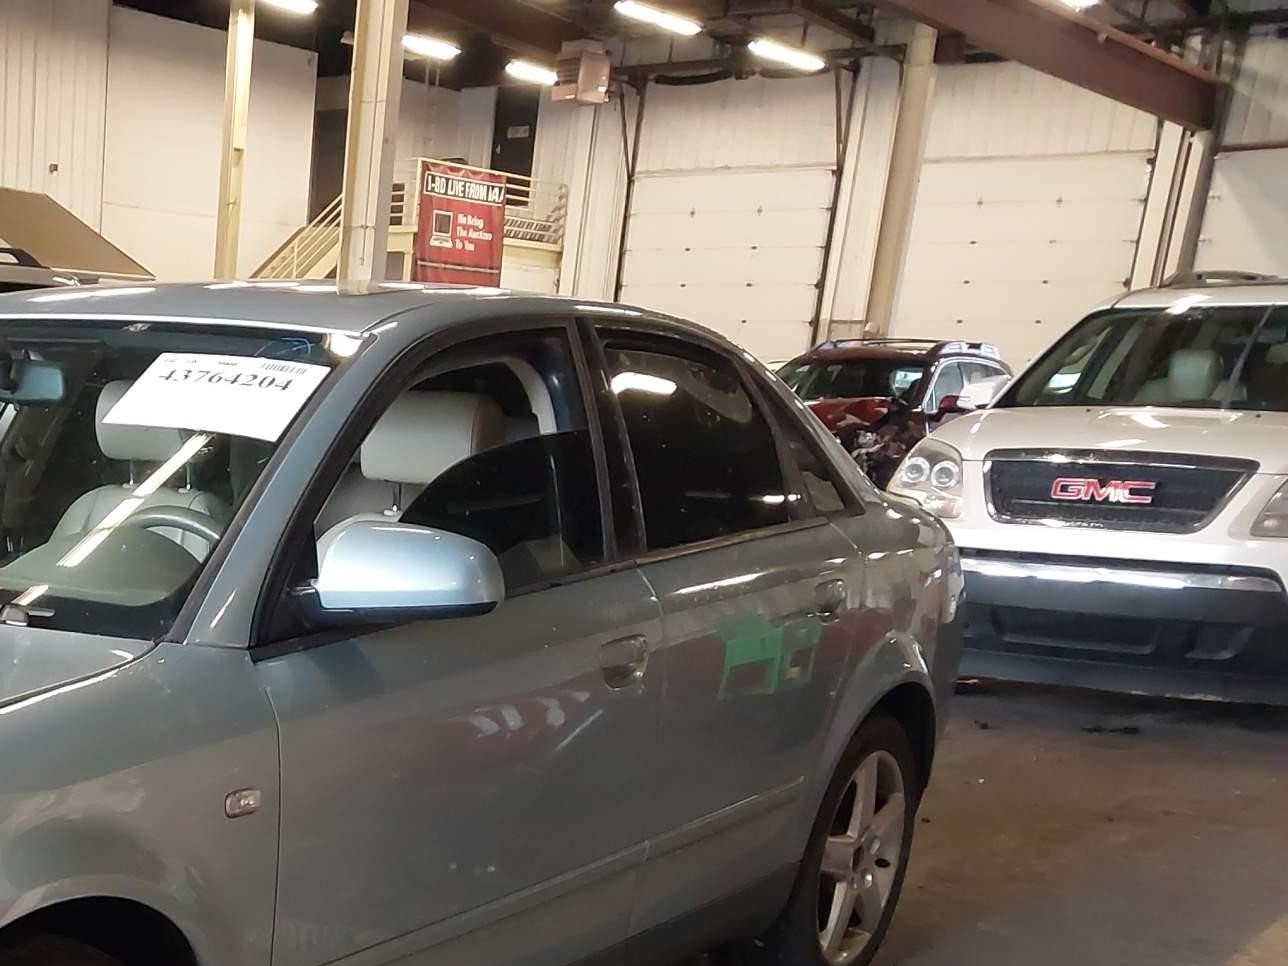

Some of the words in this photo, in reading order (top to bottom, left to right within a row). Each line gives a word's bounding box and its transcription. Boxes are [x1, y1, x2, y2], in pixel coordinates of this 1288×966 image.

[447, 179, 465, 197] LIVE
[465, 182, 487, 201] FROM
[455, 239, 463, 249] To
[464, 240, 475, 251] You
[159, 368, 293, 391] 43764204
[1051, 477, 1156, 504] GMC
